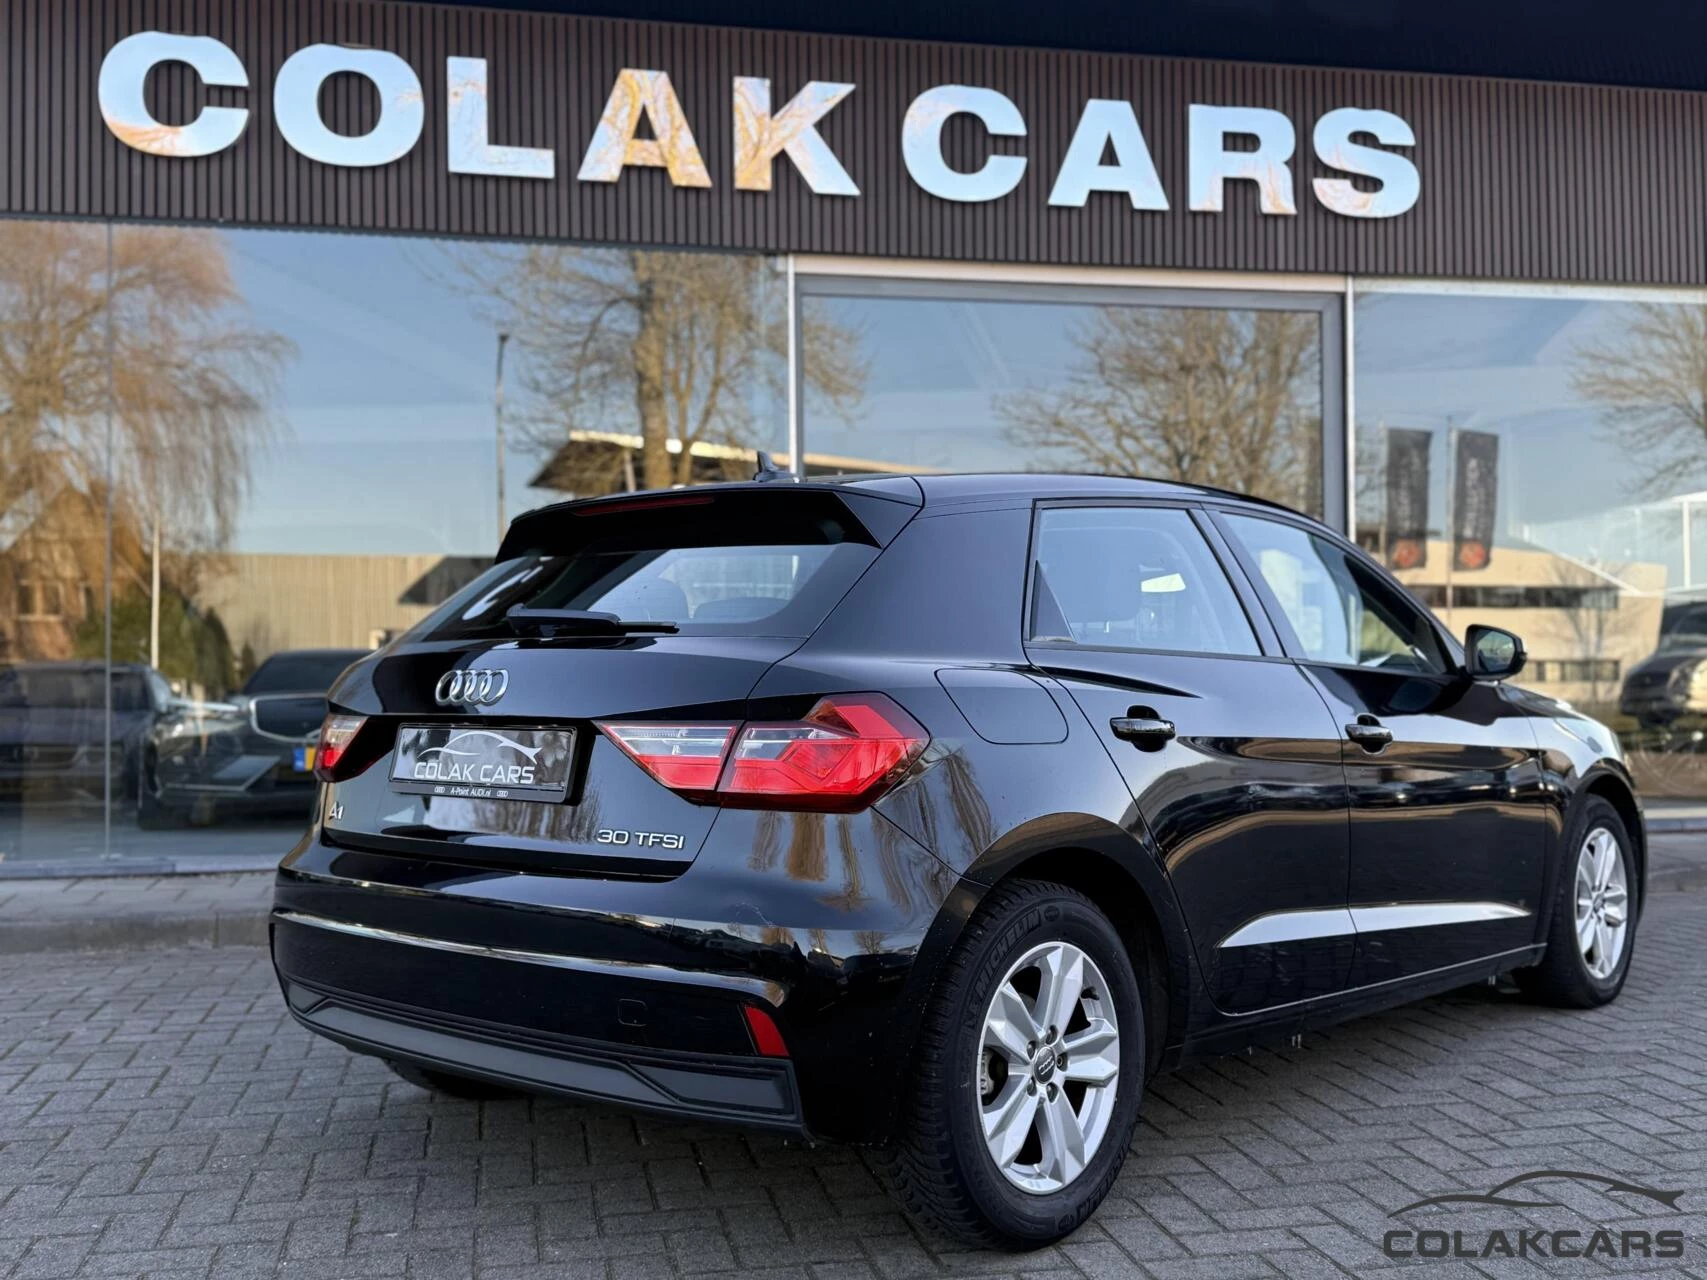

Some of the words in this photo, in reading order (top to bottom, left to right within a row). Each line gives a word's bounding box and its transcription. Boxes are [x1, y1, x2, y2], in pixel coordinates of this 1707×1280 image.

[98, 31, 861, 197] COLAK
[902, 84, 1420, 218] CARS
[414, 762, 475, 781] COLAK
[479, 765, 535, 784] CARS
[328, 801, 344, 820] A1
[597, 829, 629, 844] 30
[634, 831, 684, 849] TFSI
[974, 906, 1042, 1000] MICHELIN
